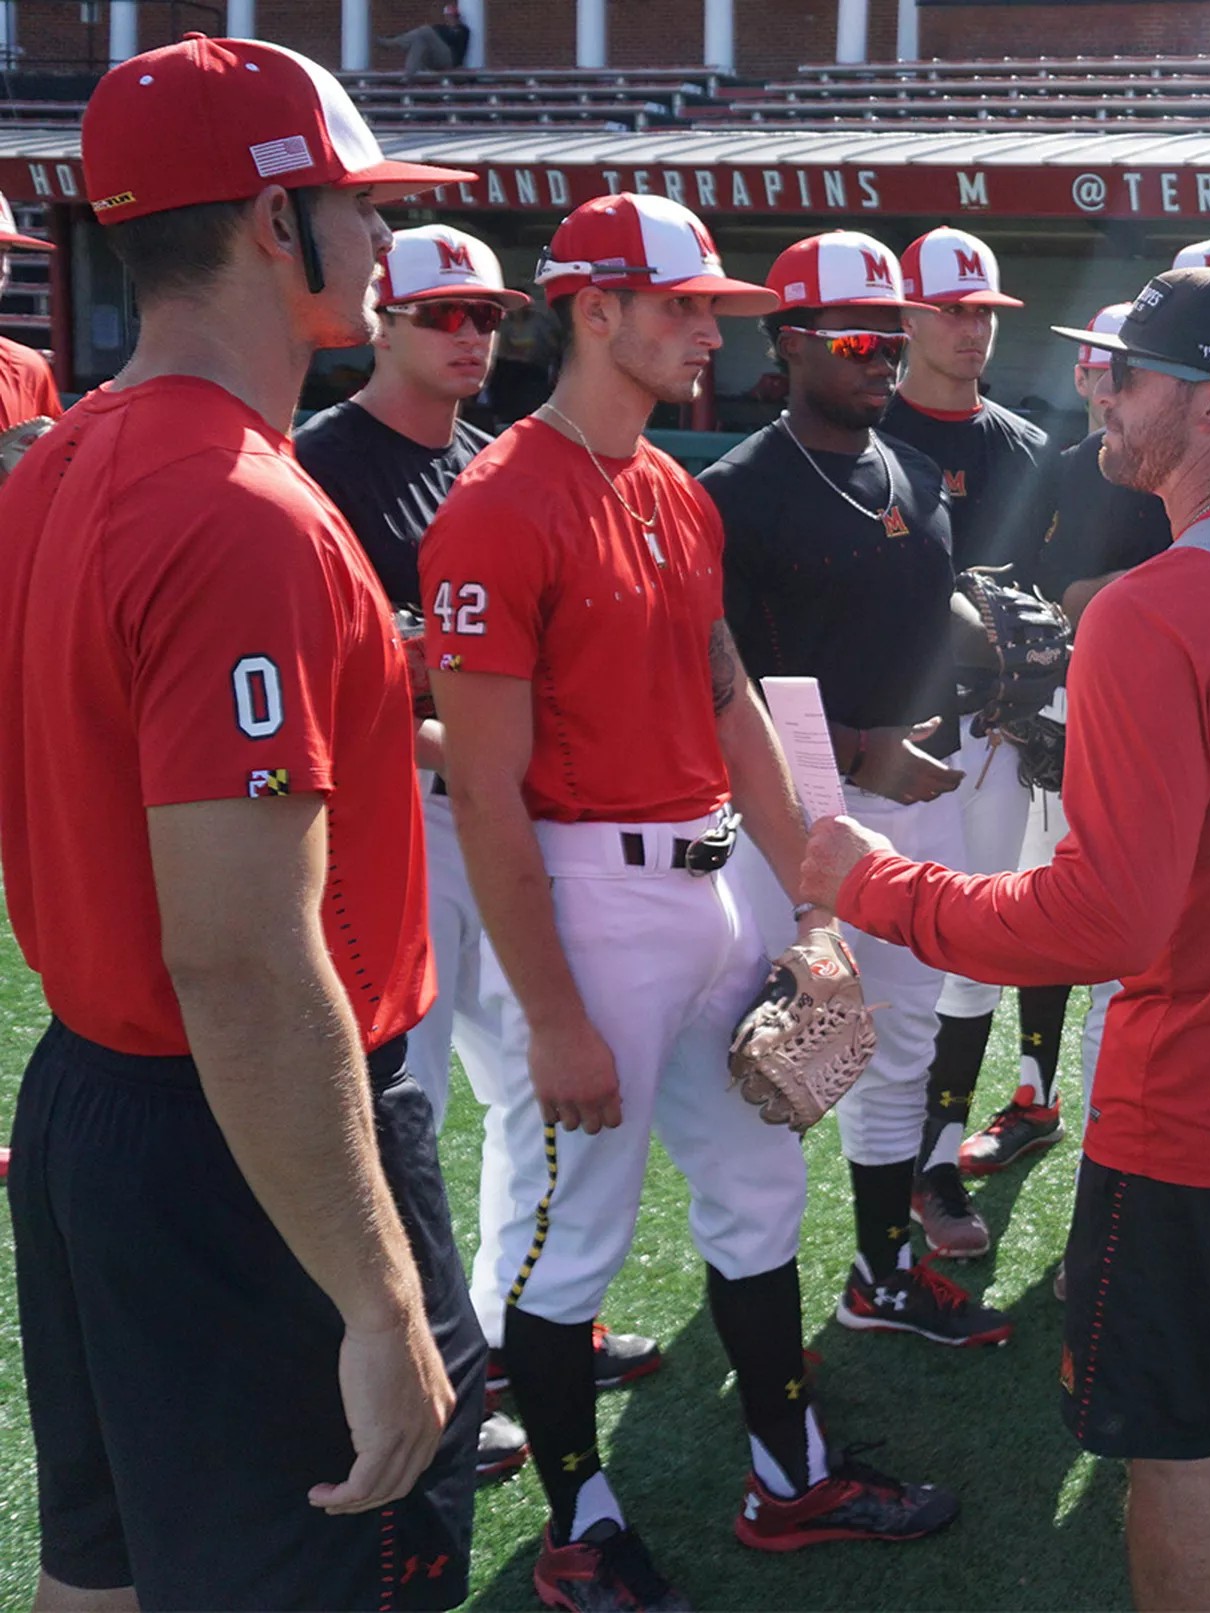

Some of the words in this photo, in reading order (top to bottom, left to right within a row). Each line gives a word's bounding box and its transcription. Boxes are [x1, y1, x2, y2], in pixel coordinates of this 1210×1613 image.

[602, 170, 881, 208] TERRAPINS
[956, 171, 990, 207] M
[433, 238, 477, 272] M
[859, 248, 893, 286] M
[953, 249, 985, 277] M
[876, 505, 909, 537] M
[432, 580, 489, 635] 42
[231, 653, 284, 741] 0
